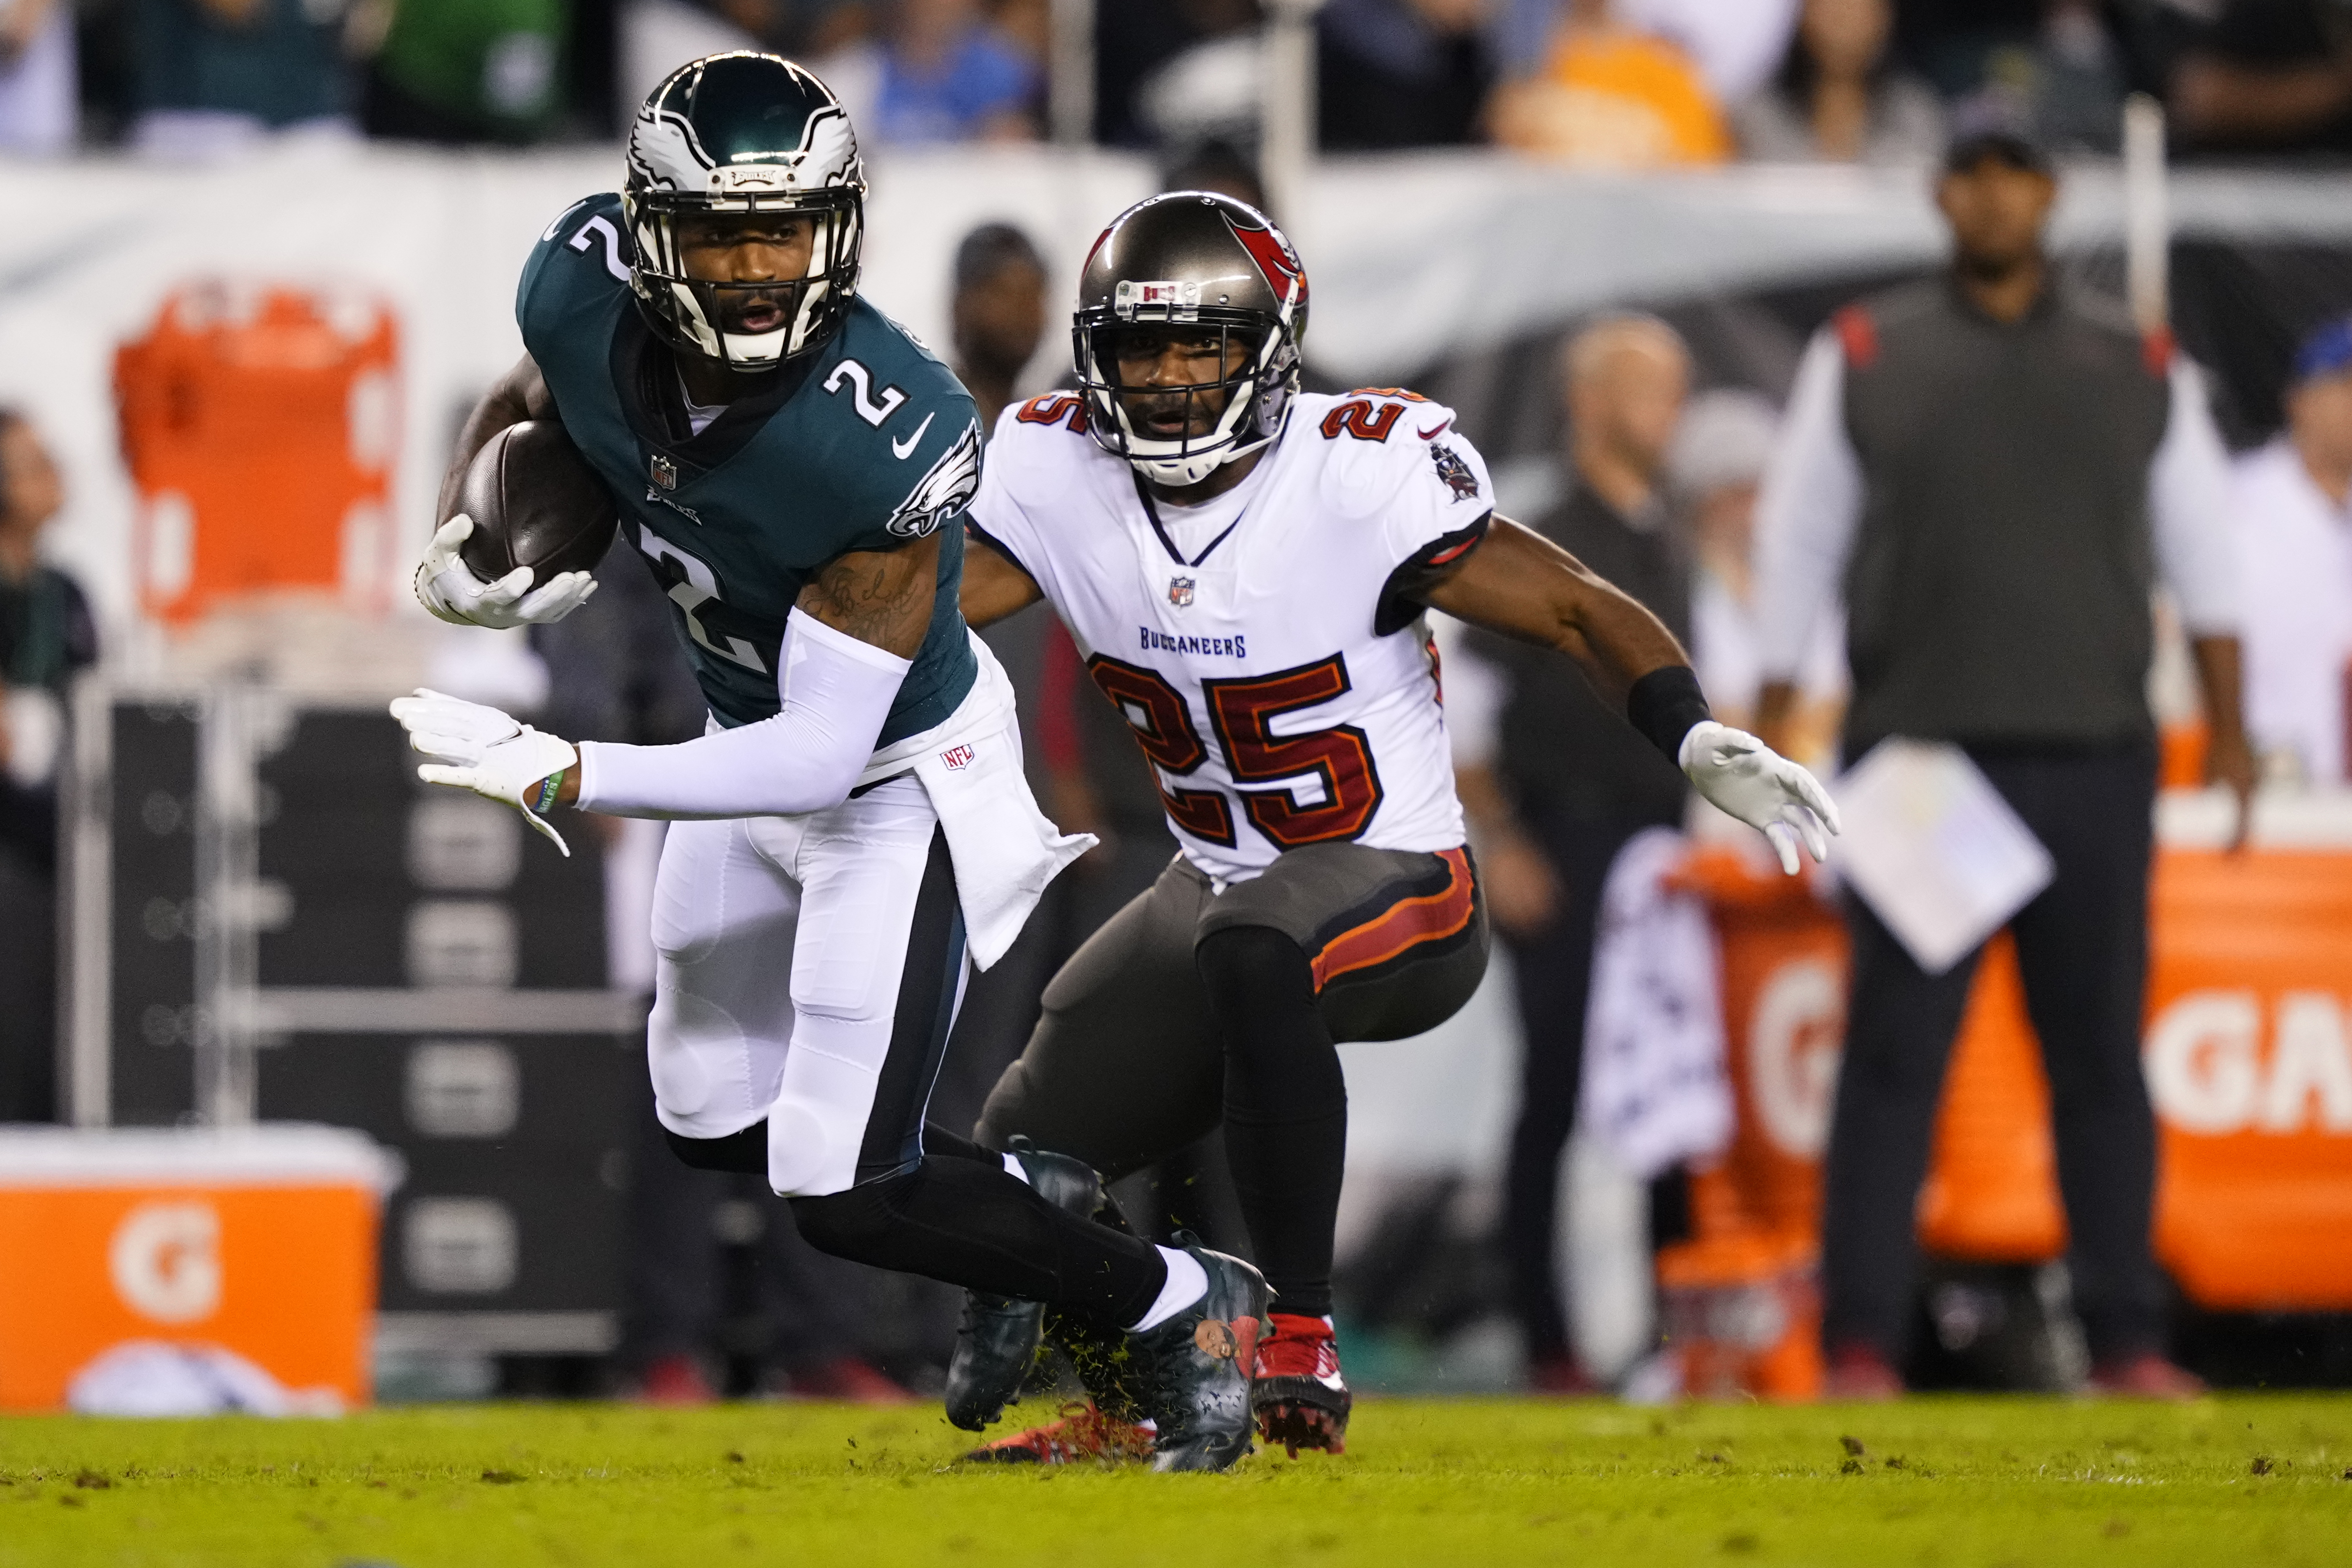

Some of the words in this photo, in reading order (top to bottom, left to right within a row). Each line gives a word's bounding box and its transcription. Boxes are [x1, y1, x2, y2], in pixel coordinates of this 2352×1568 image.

[822, 357, 911, 431] 2
[1016, 394, 1088, 436] 5
[1320, 387, 1432, 443] 2
[637, 520, 771, 676] 2
[1139, 625, 1246, 658] BUCCANEERS
[943, 746, 972, 767] NFL
[1087, 651, 1384, 853] 25
[107, 1199, 224, 1325] G
